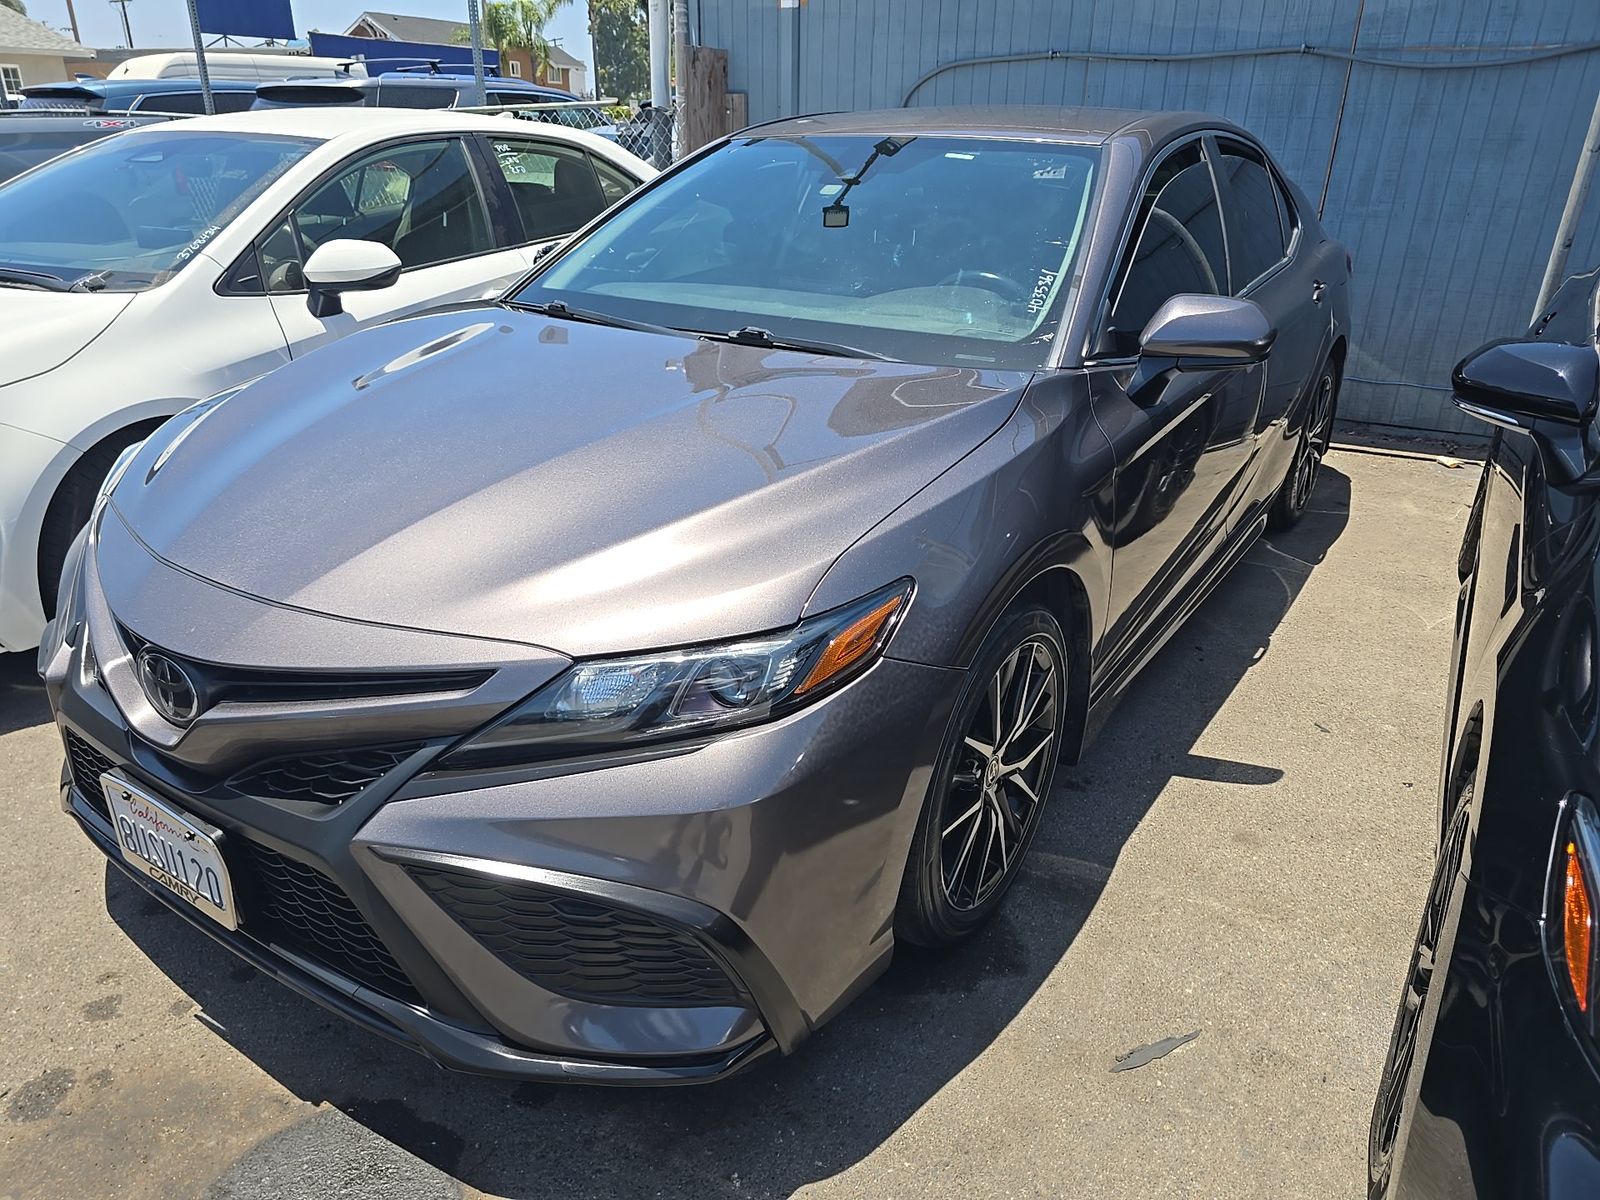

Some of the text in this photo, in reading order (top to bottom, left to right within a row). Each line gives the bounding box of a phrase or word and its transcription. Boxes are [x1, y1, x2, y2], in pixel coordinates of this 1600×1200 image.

[1027, 268, 1060, 313] 4035361
[119, 814, 226, 911] 8USU120
[149, 866, 200, 904] CAMRY
